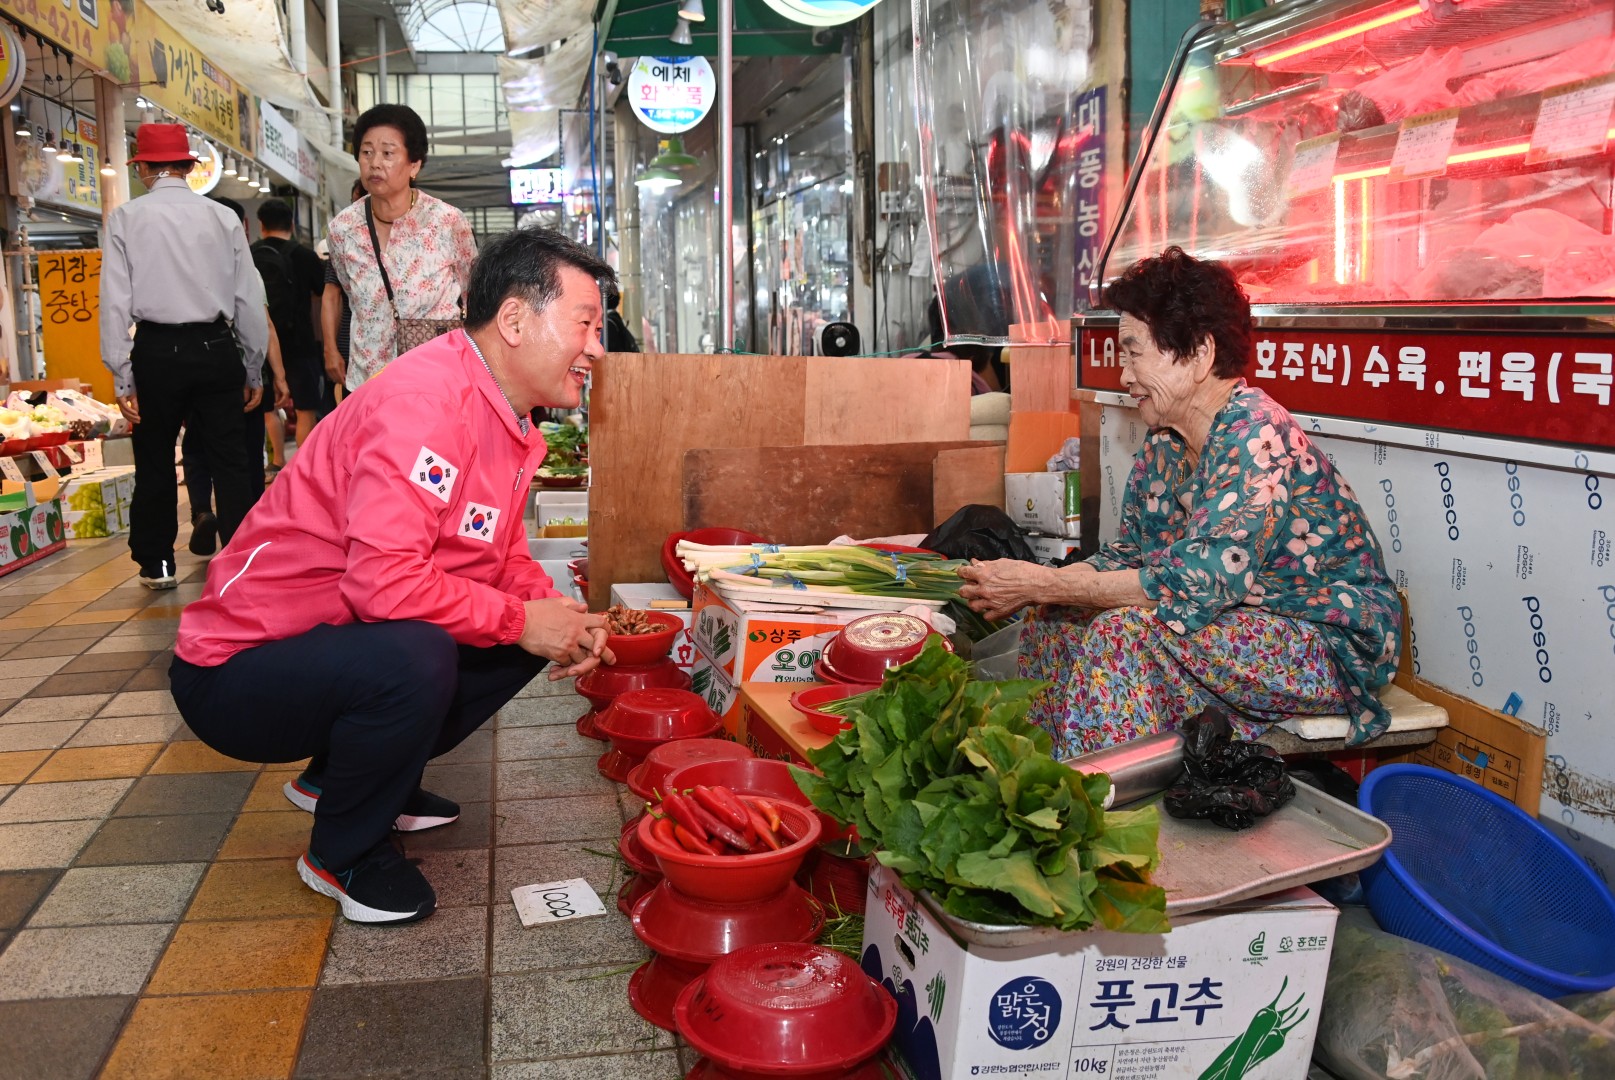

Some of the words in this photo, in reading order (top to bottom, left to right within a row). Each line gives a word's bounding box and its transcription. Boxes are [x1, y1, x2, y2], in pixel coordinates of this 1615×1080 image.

[641, 84, 702, 105] 화품
[46, 290, 92, 323] 중탕
[1091, 337, 1126, 367] LA
[1255, 340, 1351, 386] 호주산)
[1105, 465, 1118, 516] posco
[1434, 461, 1459, 541] posco
[1379, 479, 1401, 553] posco
[1521, 545, 1529, 579] posco
[1597, 530, 1606, 567] posco
[770, 629, 801, 643] 상주
[1457, 606, 1483, 687] posco
[1522, 597, 1552, 683] posco
[771, 649, 820, 675] 오이
[1466, 764, 1480, 779] 성명
[1297, 936, 1328, 948] 홍천군
[1095, 959, 1128, 972] 강원의
[1130, 956, 1164, 970] 건강한
[1166, 955, 1188, 969] 선물
[997, 983, 1051, 1040] 맑은청
[1089, 977, 1223, 1031] 풋고추
[981, 1062, 1061, 1074] 강원농협연합사업단
